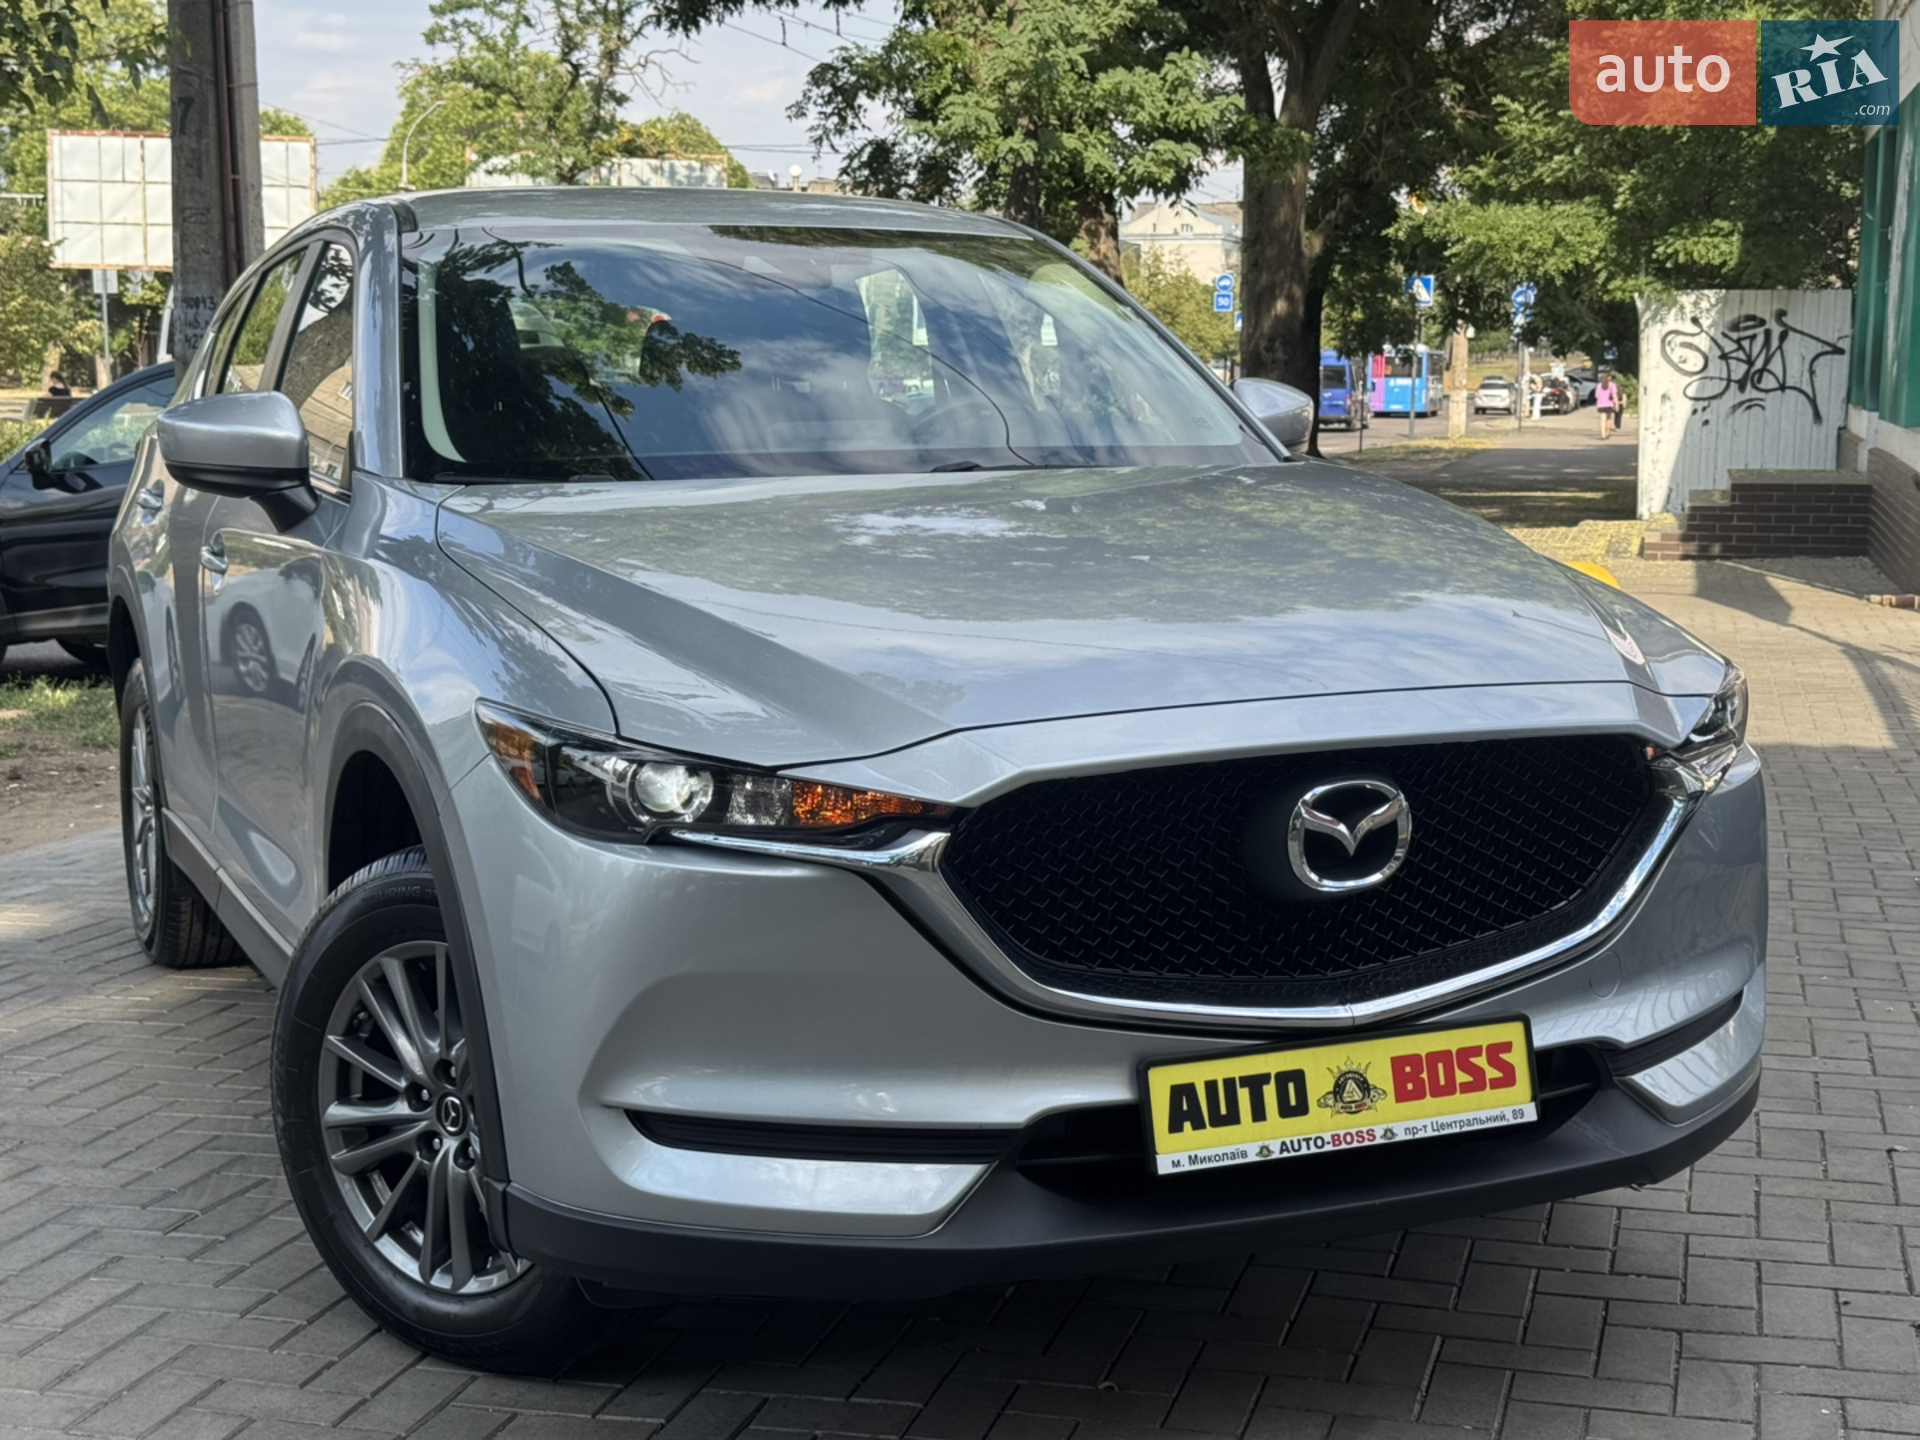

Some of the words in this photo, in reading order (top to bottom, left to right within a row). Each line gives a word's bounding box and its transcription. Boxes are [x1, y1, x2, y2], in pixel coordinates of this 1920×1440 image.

[1167, 1068, 1310, 1135] AUTO
[1390, 1041, 1518, 1104] BOSS
[1404, 1124, 1428, 1138] пр-т
[1430, 1111, 1510, 1134] Центральний,
[1512, 1107, 1525, 1120] 89
[1278, 1128, 1377, 1155] AUTO-BOSS
[1188, 1148, 1249, 1167] Миколаїв
